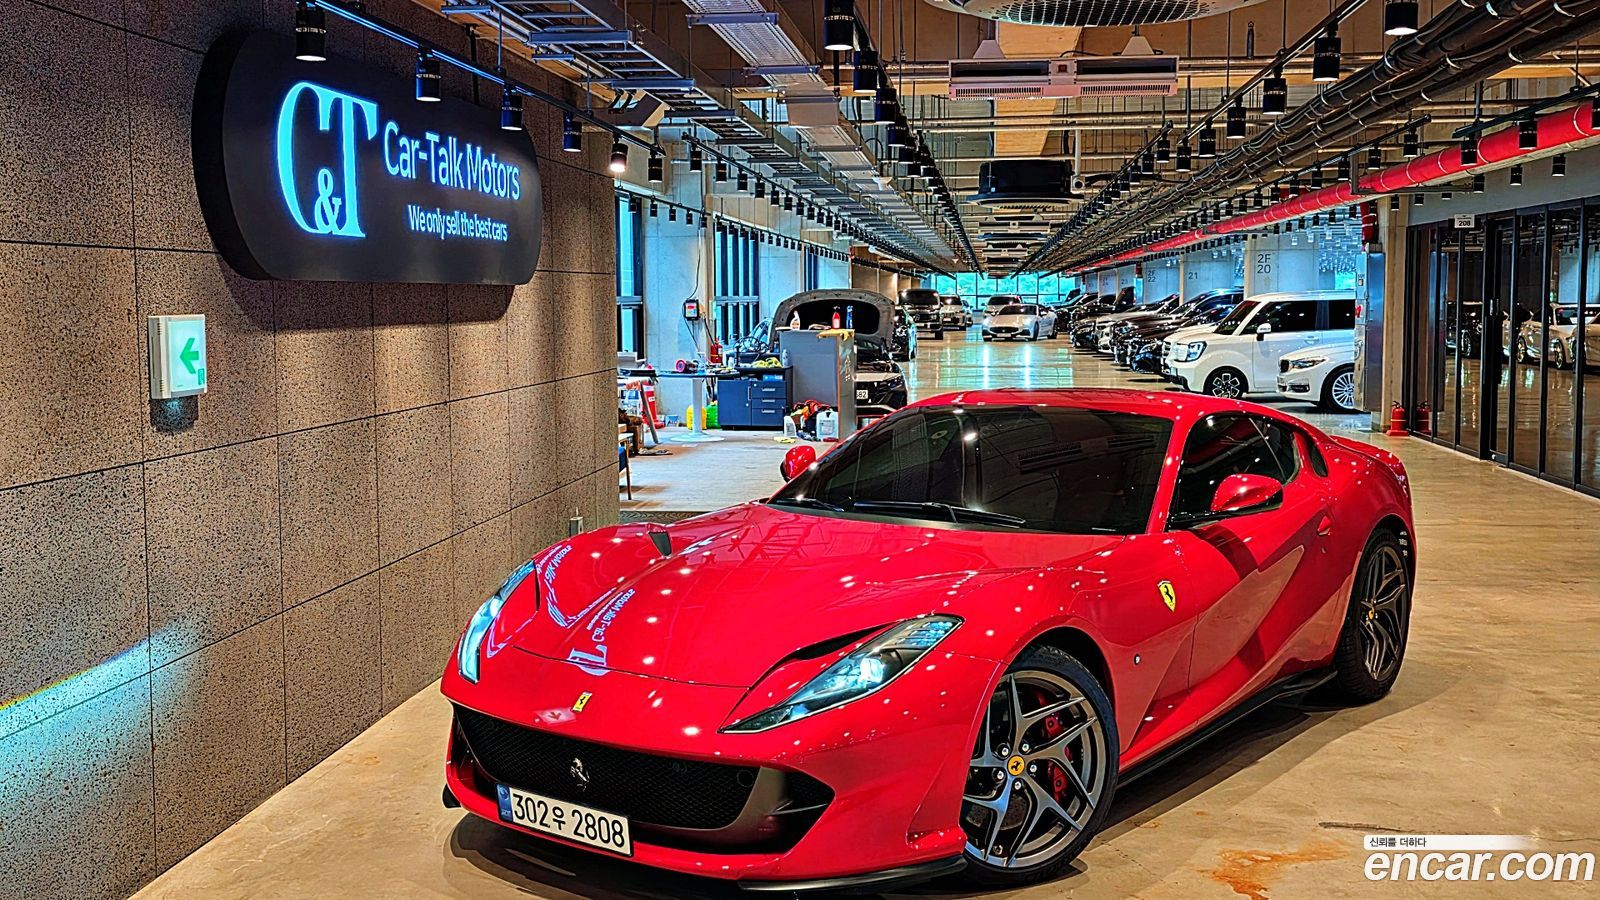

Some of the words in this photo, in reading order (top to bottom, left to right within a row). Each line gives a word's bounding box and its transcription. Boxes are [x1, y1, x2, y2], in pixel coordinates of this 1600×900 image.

[384, 121, 465, 189] Car-Talk
[466, 143, 520, 200] Motors
[408, 204, 426, 232] We
[426, 207, 446, 240] only
[446, 210, 460, 236] sell
[461, 211, 474, 237] the
[474, 213, 492, 240] best
[492, 221, 508, 242] cars
[1257, 253, 1271, 264] 2F
[1257, 264, 1271, 274] 20
[1188, 272, 1198, 280] 21
[512, 793, 566, 831] 302우
[572, 809, 625, 848] 2808
